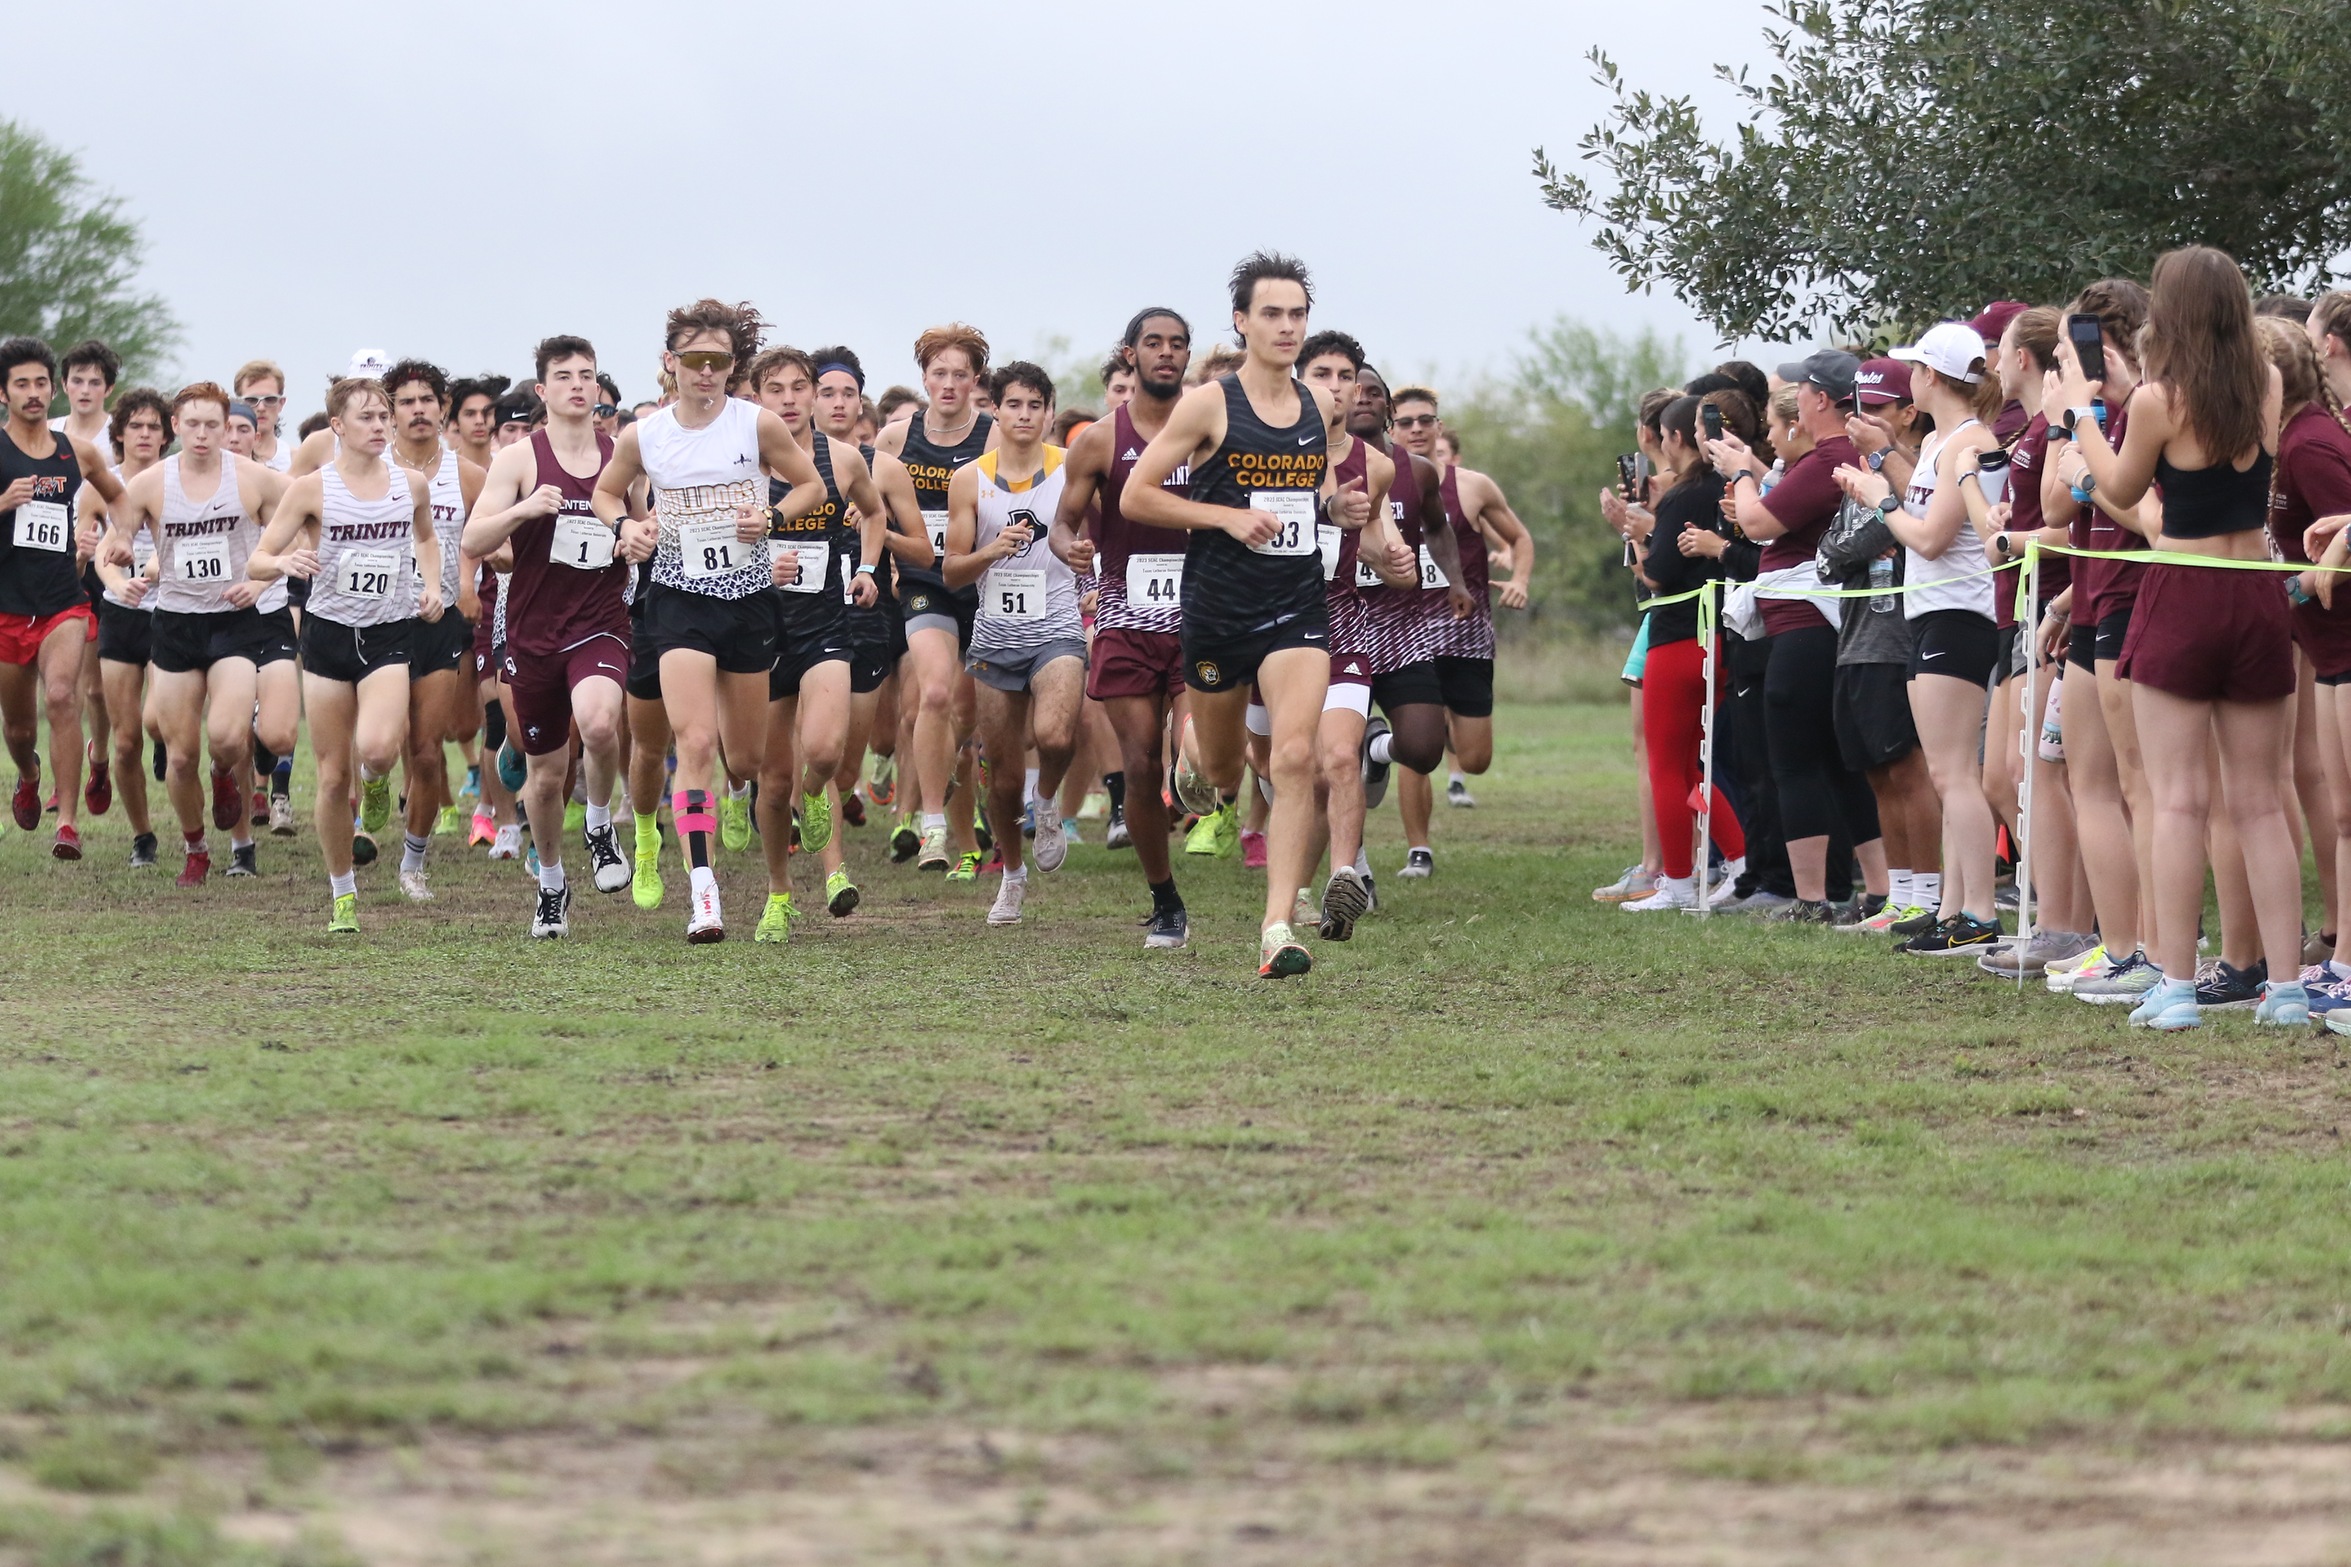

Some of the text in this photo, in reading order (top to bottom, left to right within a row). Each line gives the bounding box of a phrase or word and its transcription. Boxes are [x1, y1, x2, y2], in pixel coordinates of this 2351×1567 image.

[903, 463, 954, 480] OLORA
[1228, 453, 1324, 470] COLORADO
[911, 478, 950, 492] OLLE
[1236, 471, 1317, 488] COLLEGE
[26, 522, 60, 544] 166
[165, 516, 240, 537] TRINITY
[330, 521, 411, 542] TRINITY
[1271, 521, 1300, 548] 33
[578, 541, 588, 563] 1
[703, 545, 733, 570] 81
[186, 558, 221, 578] 130
[350, 572, 388, 594] 120
[1147, 578, 1175, 601] 44
[1002, 592, 1026, 613] 51
